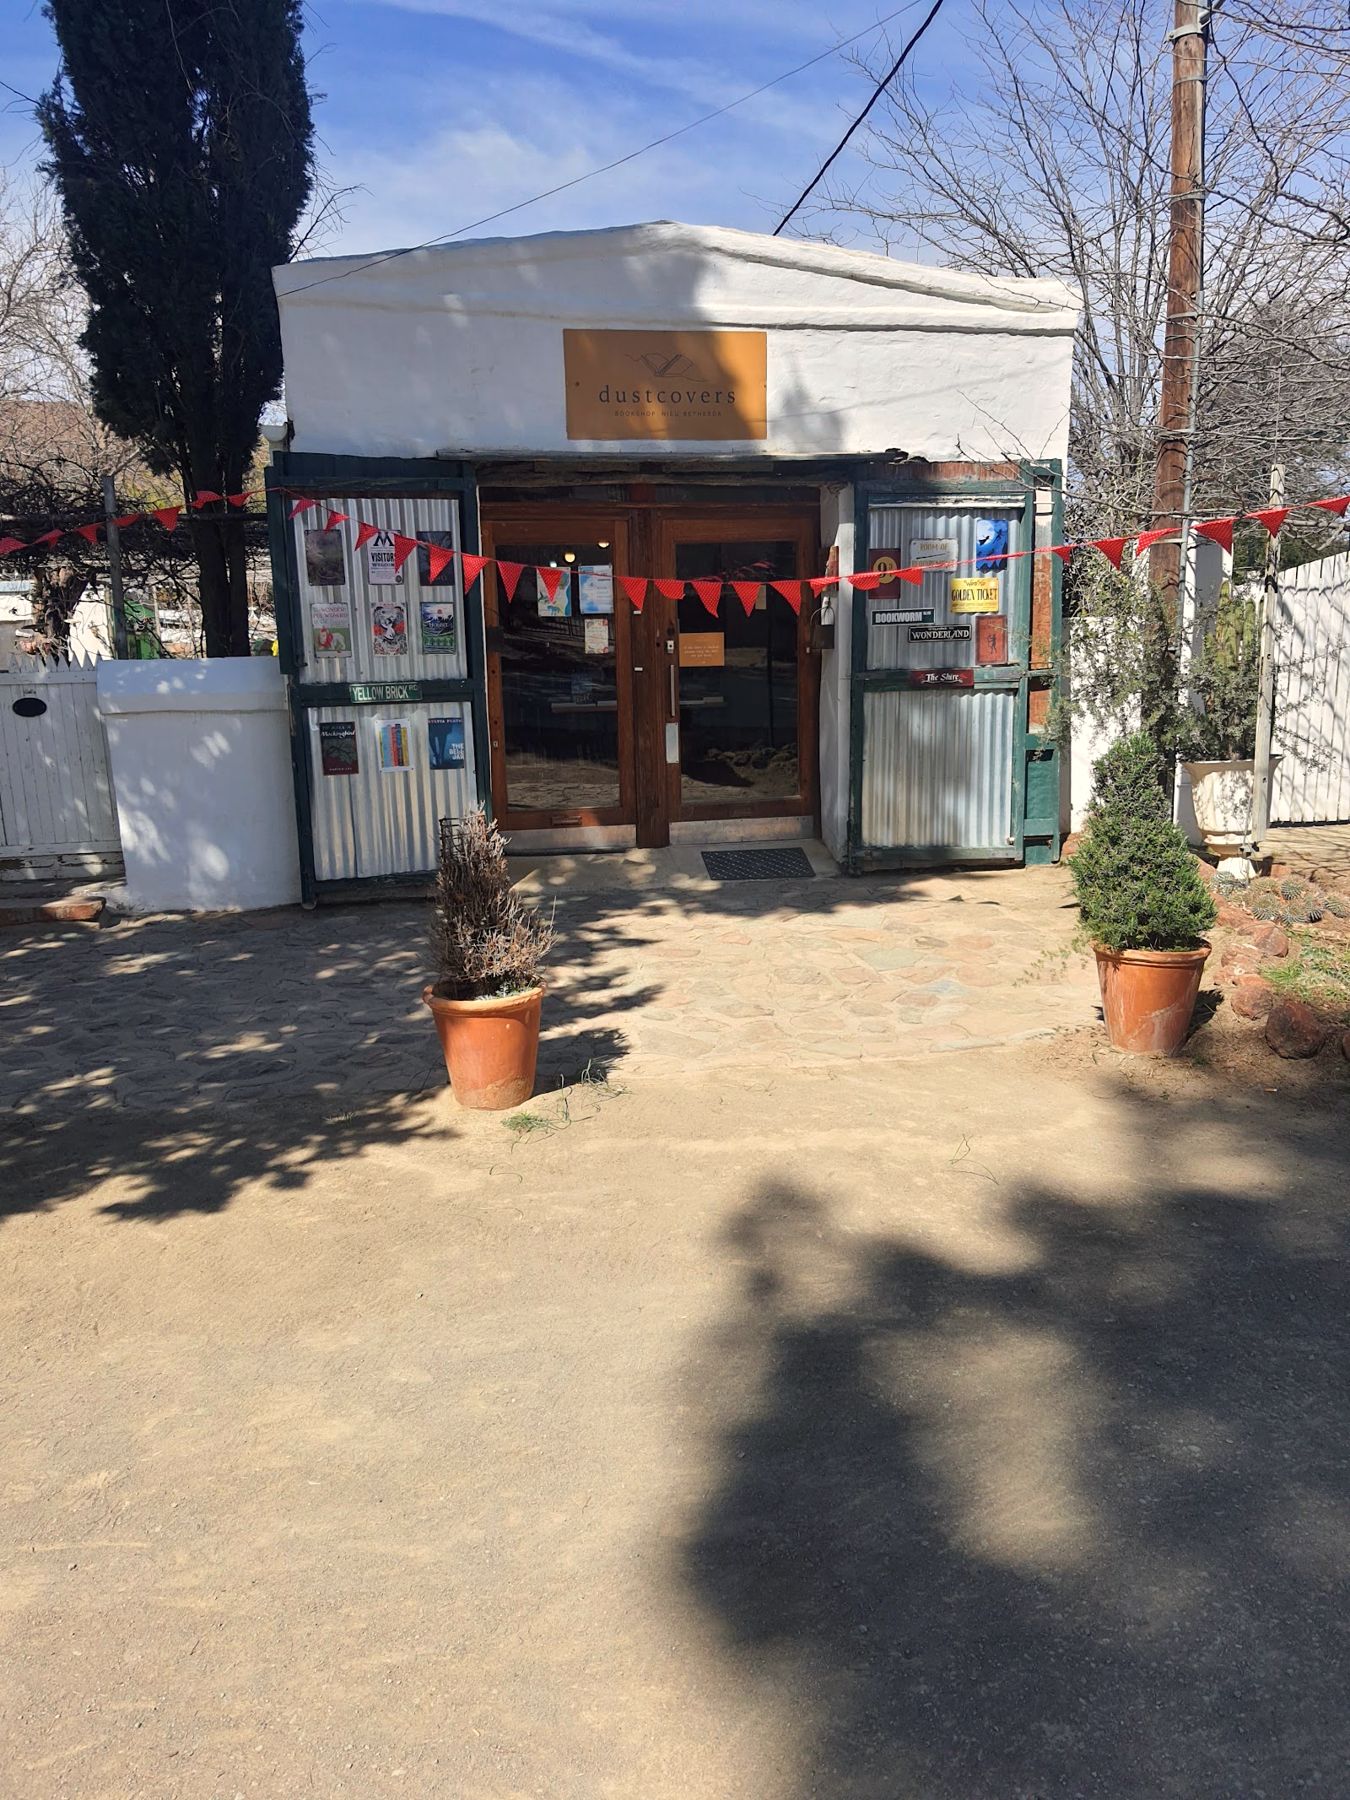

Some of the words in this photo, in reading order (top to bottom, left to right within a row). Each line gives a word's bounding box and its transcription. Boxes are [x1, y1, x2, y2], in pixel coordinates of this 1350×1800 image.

[599, 384, 736, 404] dustcovers
[951, 588, 975, 601] GOLDEN
[977, 588, 998, 601] TICKET
[875, 611, 923, 624] BOOKWORM
[911, 629, 970, 640] WONDERLAND
[925, 673, 939, 682] The
[941, 673, 959, 681] Shire
[353, 685, 384, 701] YELLOW
[385, 685, 409, 699] BRICK
